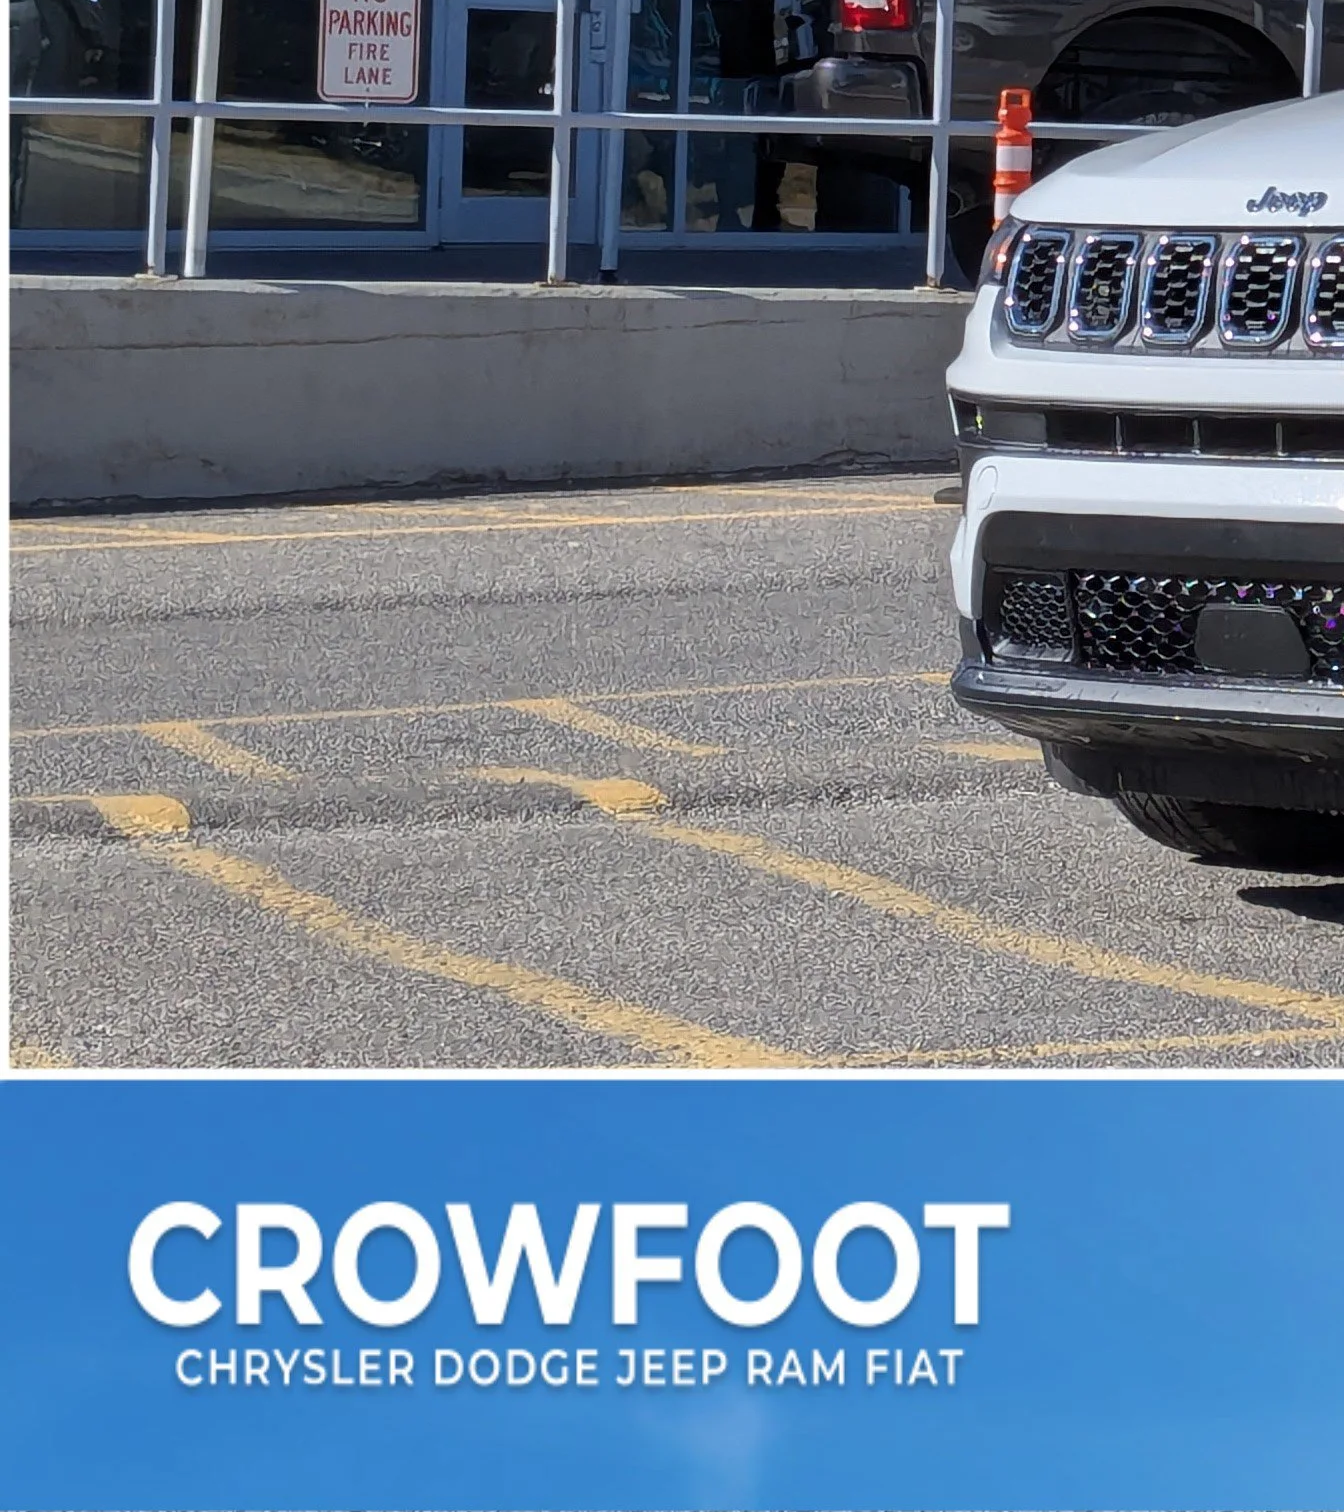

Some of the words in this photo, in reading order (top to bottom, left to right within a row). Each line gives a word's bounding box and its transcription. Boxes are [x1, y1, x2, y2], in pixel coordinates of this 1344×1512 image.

[327, 9, 413, 38] PARKING
[347, 42, 391, 62] FIRE
[343, 66, 393, 86] LANE
[1245, 186, 1330, 218] Jeep
